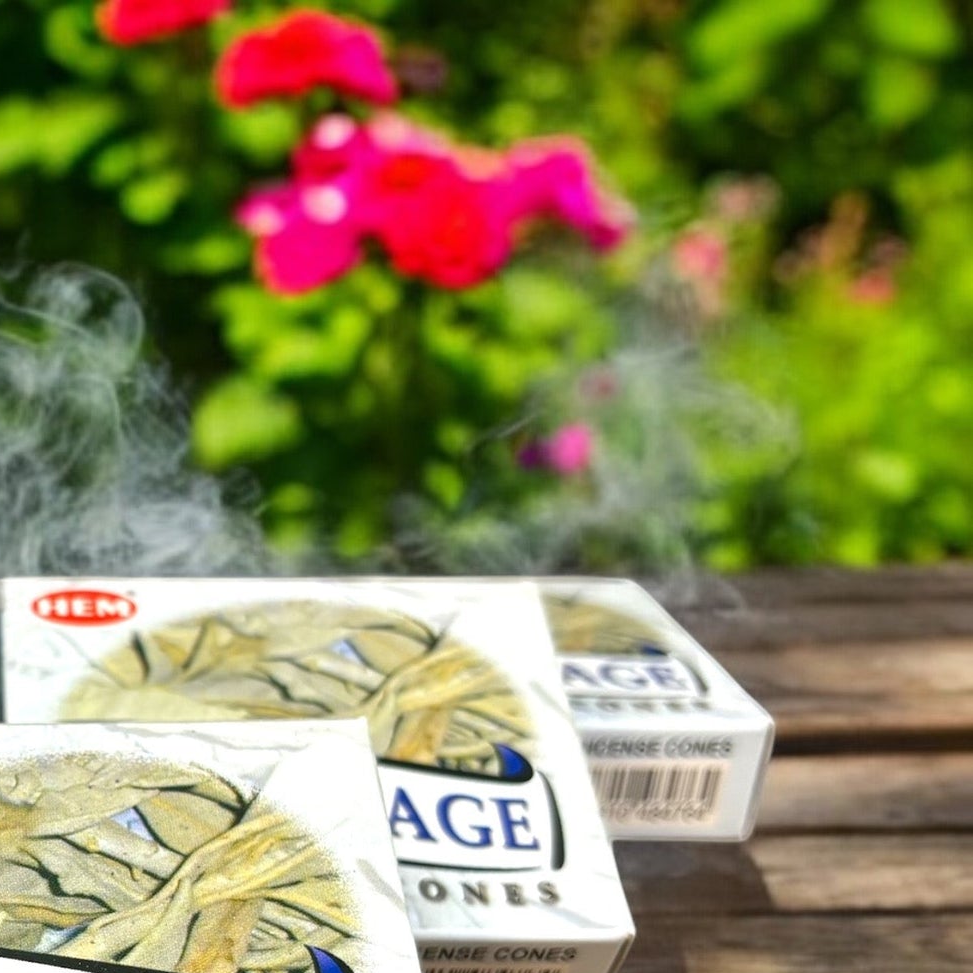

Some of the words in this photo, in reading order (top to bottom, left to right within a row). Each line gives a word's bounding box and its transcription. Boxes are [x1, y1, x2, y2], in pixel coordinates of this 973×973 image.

[37, 598, 130, 618] HEM
[561, 661, 691, 691] AGE
[389, 785, 542, 852] AGE
[418, 877, 562, 907] ONES
[422, 946, 487, 962] ENSE
[493, 946, 578, 962] CONES
